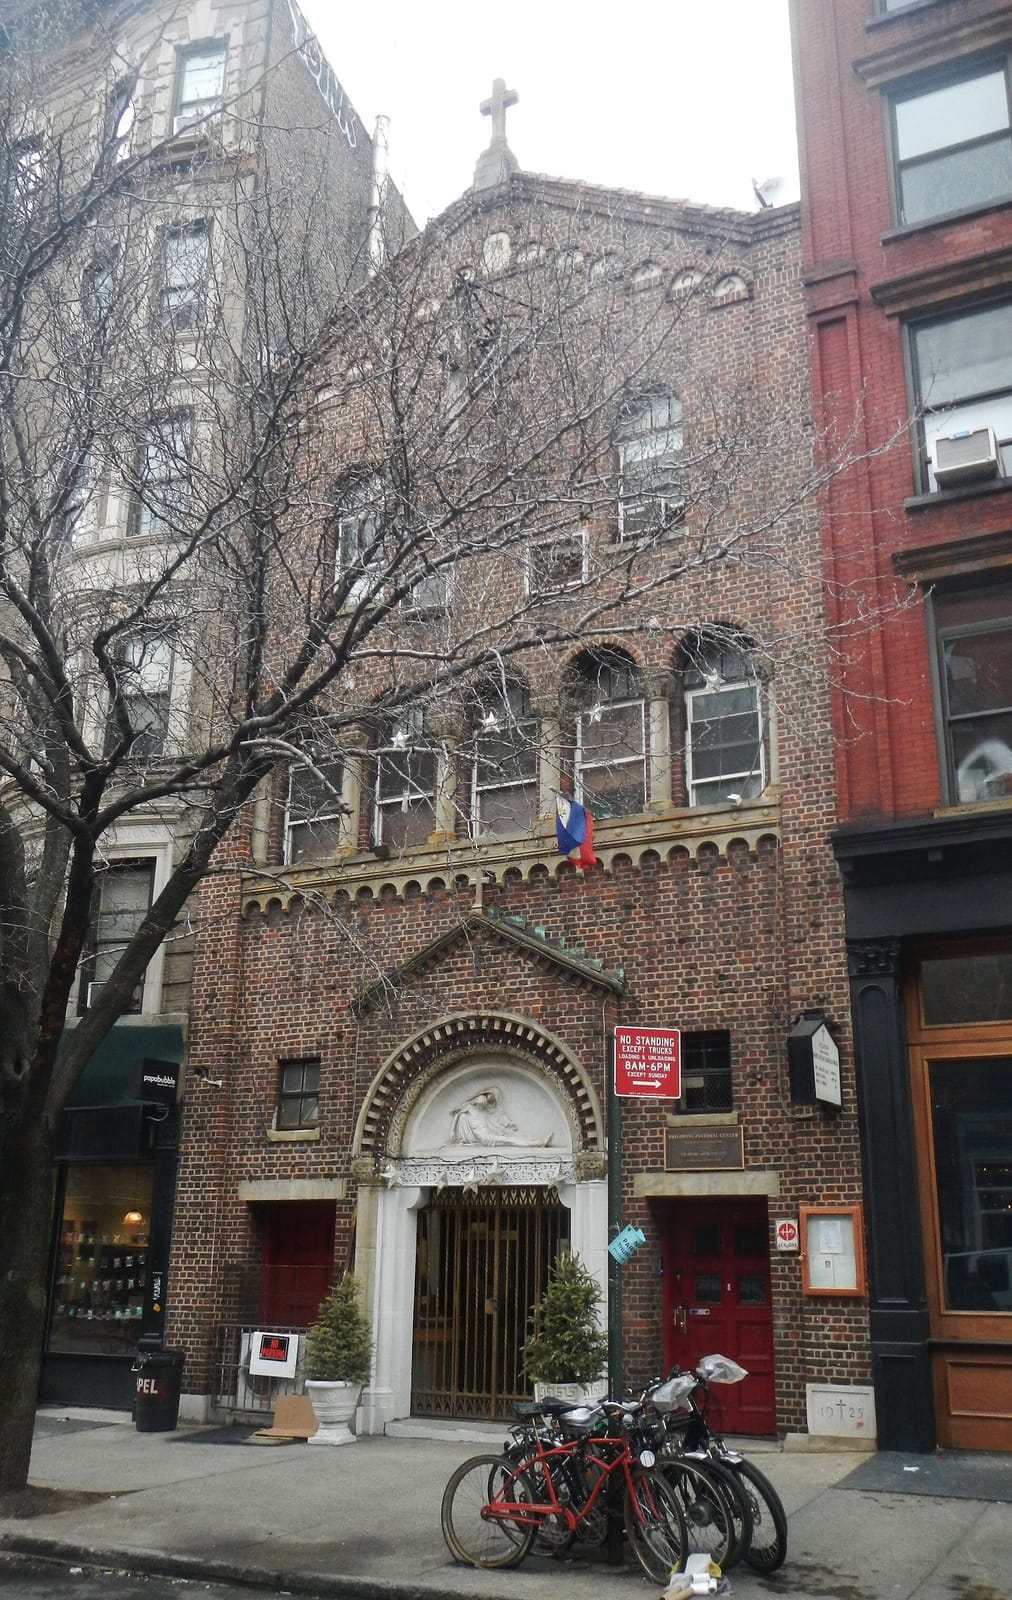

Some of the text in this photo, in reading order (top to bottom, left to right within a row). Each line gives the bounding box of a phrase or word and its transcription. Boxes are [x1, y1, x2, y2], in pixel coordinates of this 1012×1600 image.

[620, 1035, 675, 1047] NO STANDING
[622, 1045, 673, 1055] EXCEPT TRUCKS
[625, 1061, 671, 1072] 8AM-6PM
[143, 1074, 176, 1085] papabubble
